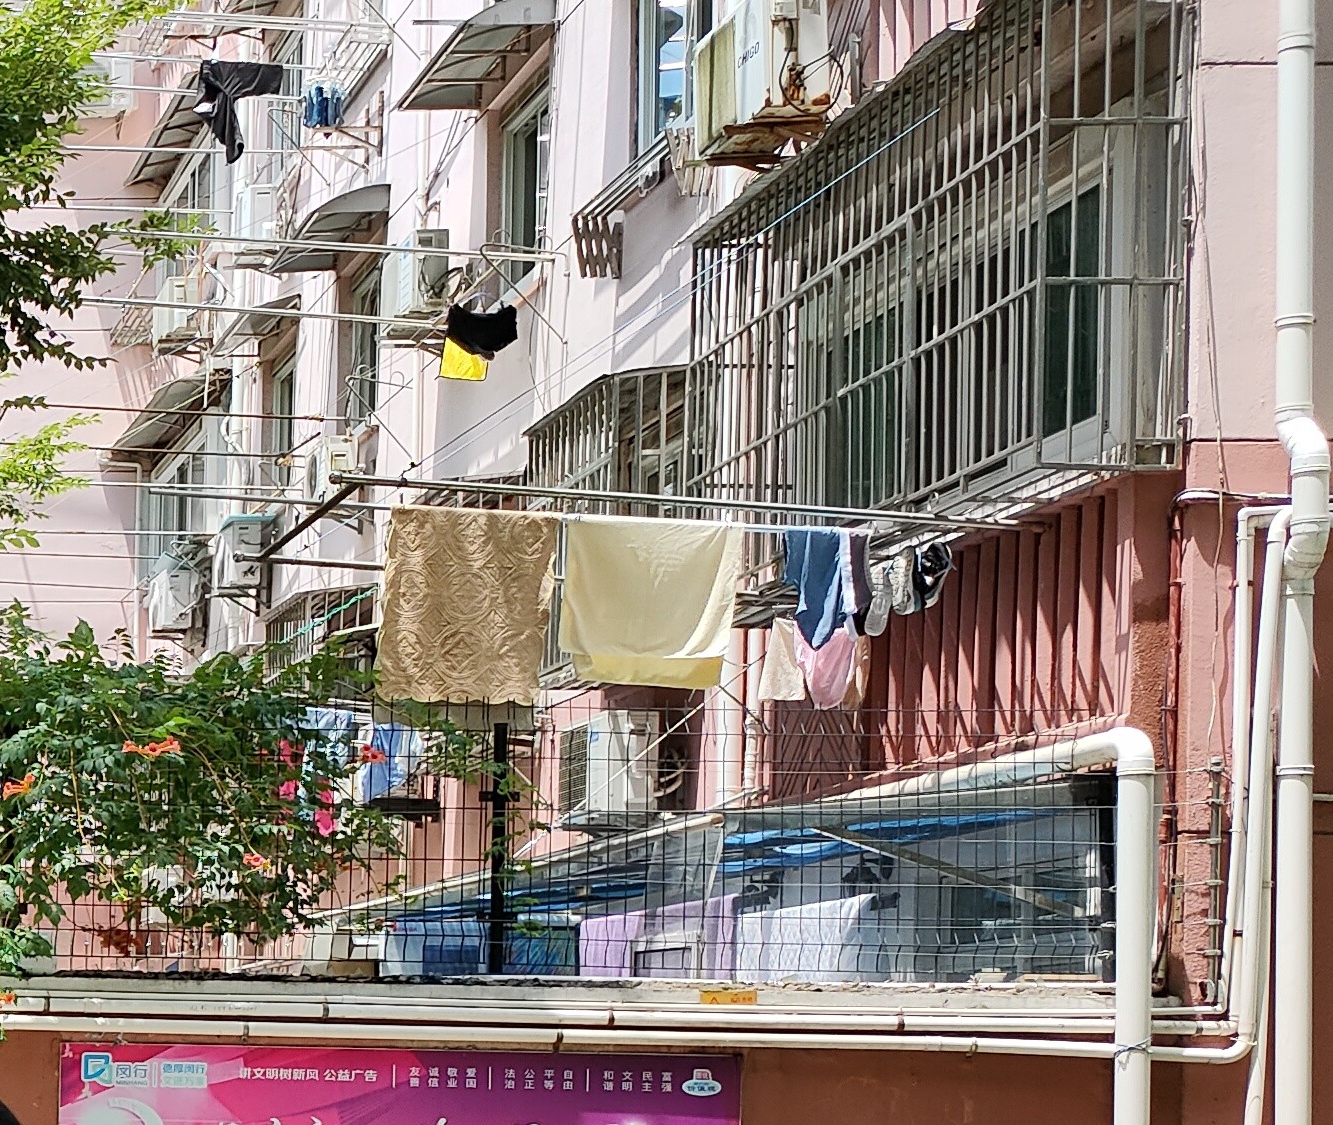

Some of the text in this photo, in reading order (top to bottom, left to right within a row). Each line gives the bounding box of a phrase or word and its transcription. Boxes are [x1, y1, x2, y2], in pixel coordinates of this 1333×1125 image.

[738, 41, 760, 69] CHIGO
[116, 1064, 148, 1079] 闵行
[239, 1067, 378, 1083] 讲文明树新风 公益广告
